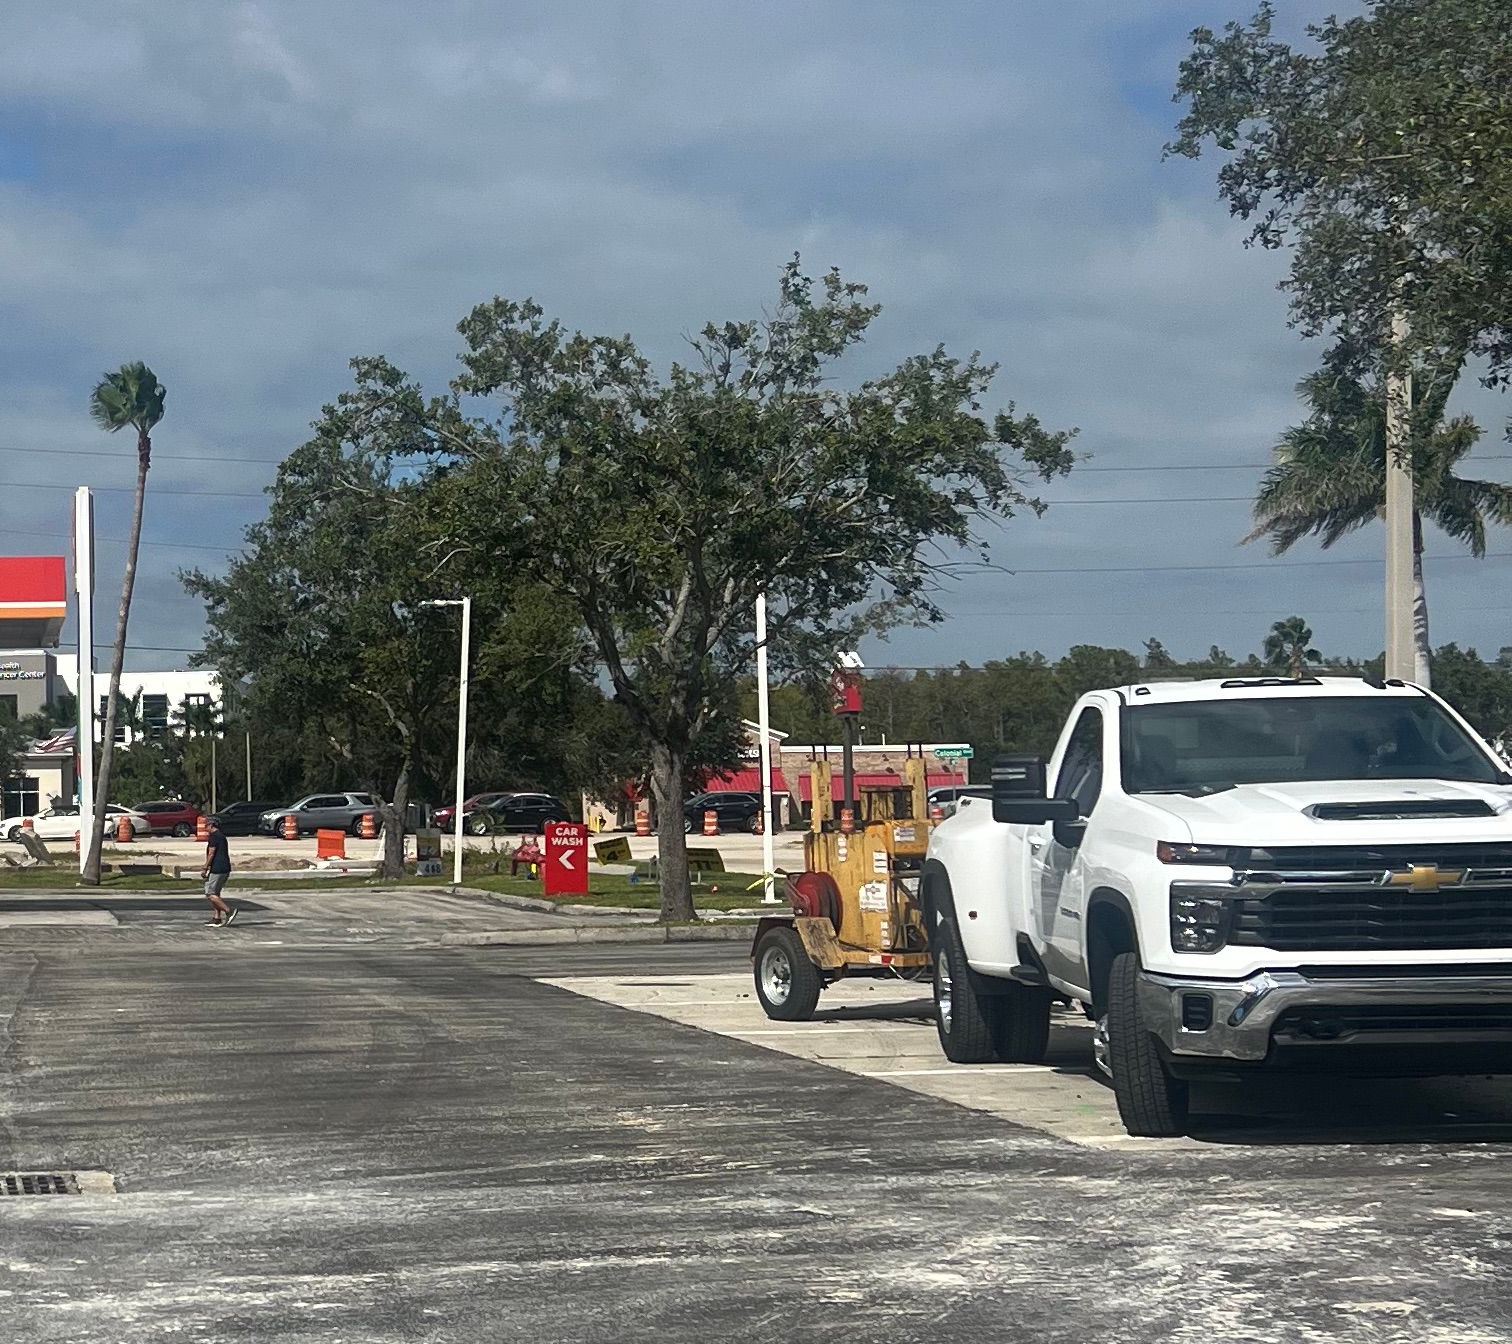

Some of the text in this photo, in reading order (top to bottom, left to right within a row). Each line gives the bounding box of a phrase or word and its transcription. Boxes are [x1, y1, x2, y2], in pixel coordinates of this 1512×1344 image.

[18, 670, 45, 678] Center
[555, 827, 579, 836] CAR
[550, 837, 584, 846] WASH
